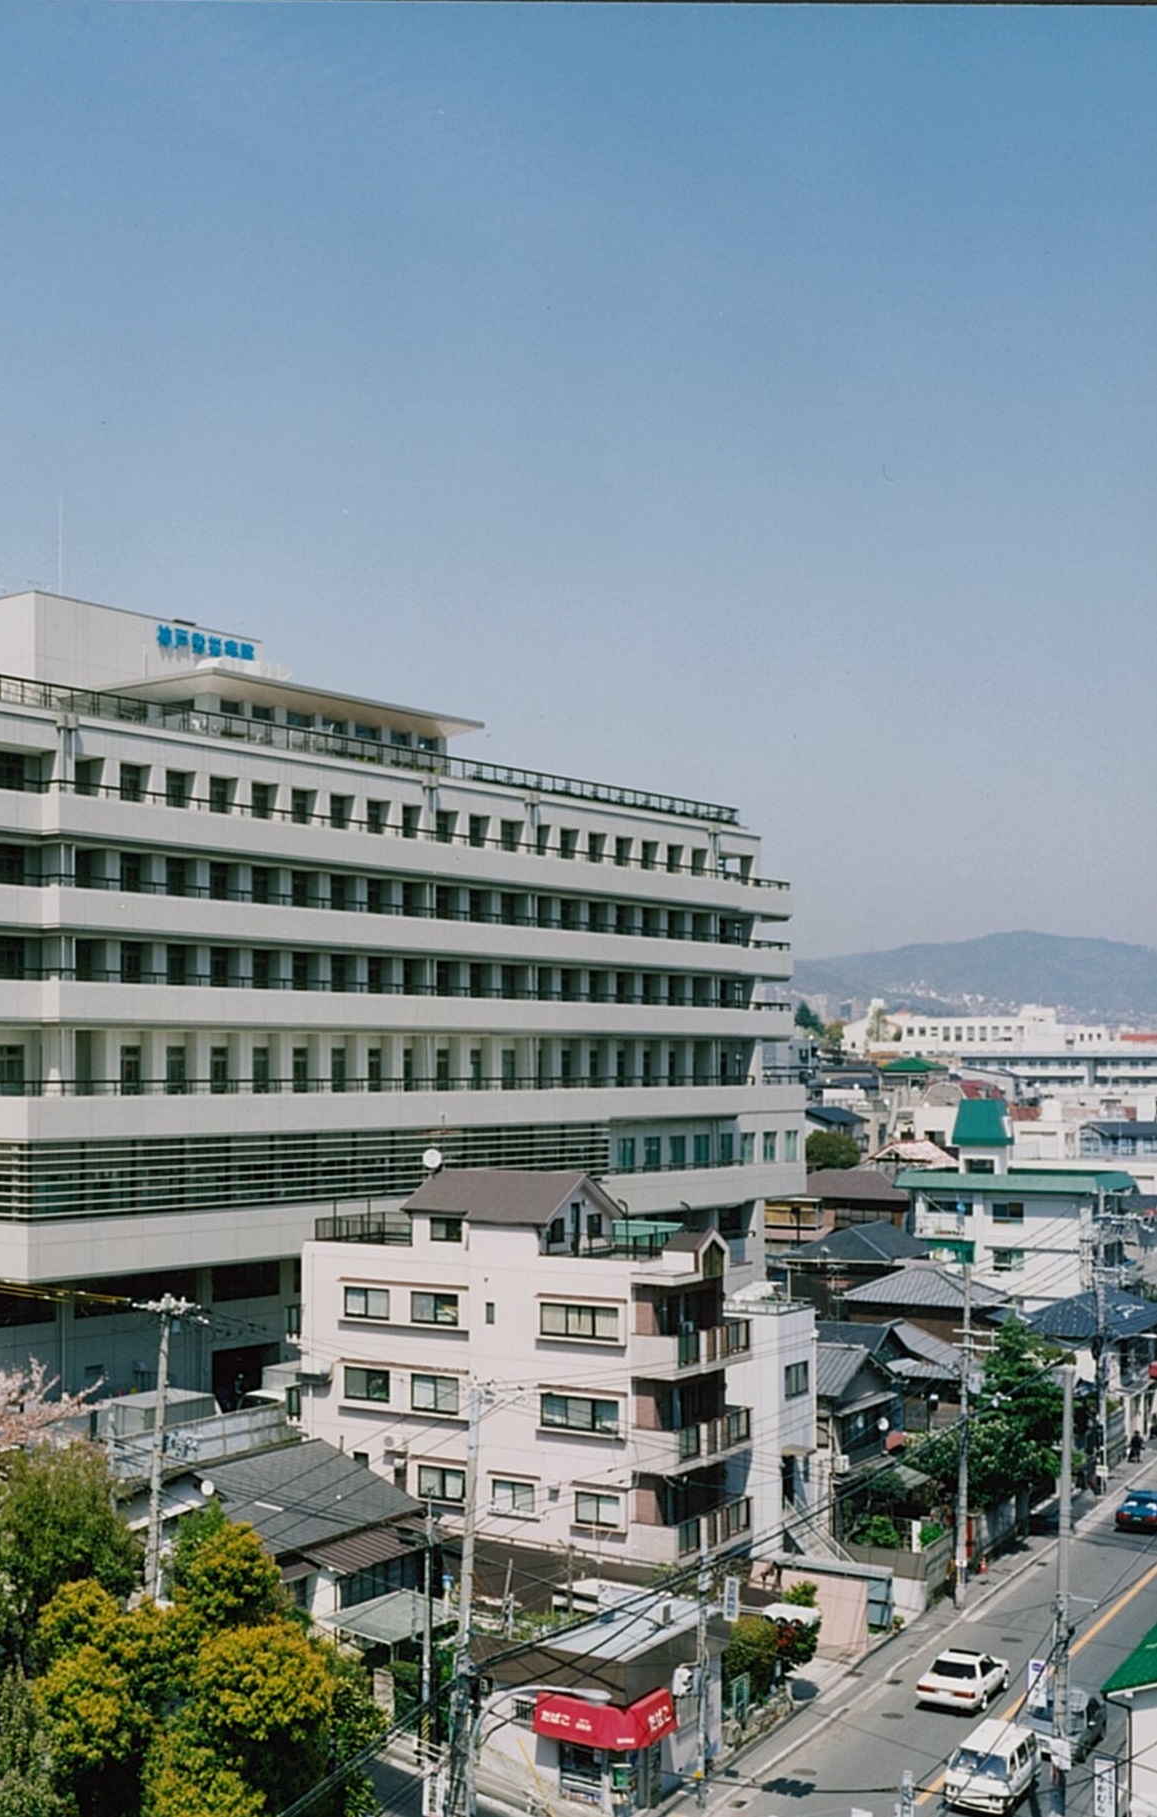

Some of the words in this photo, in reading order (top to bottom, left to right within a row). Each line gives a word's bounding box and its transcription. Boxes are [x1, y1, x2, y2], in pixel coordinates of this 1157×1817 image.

[540, 1710, 570, 1726] たばこ
[647, 1705, 672, 1732] たばこ
